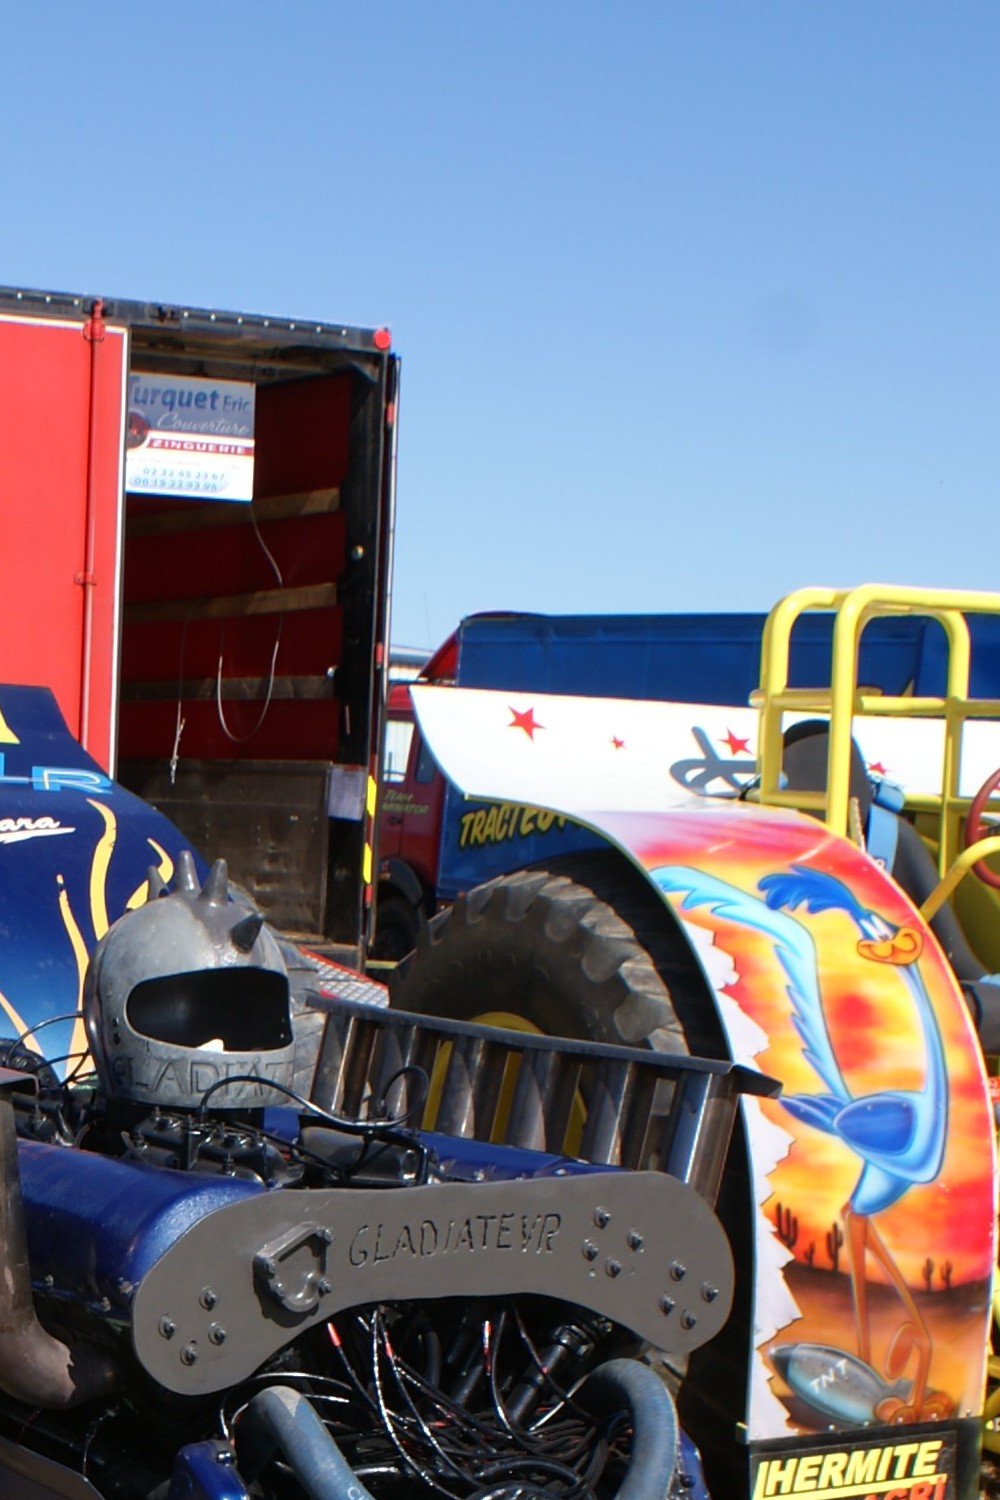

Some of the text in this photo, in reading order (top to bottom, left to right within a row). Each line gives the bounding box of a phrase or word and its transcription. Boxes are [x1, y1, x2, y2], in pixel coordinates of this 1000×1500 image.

[222, 393, 250, 413] Eric
[156, 410, 251, 437] Couverture
[151, 439, 245, 454] ZINGUERIE
[809, 1359, 850, 1394] TNT
